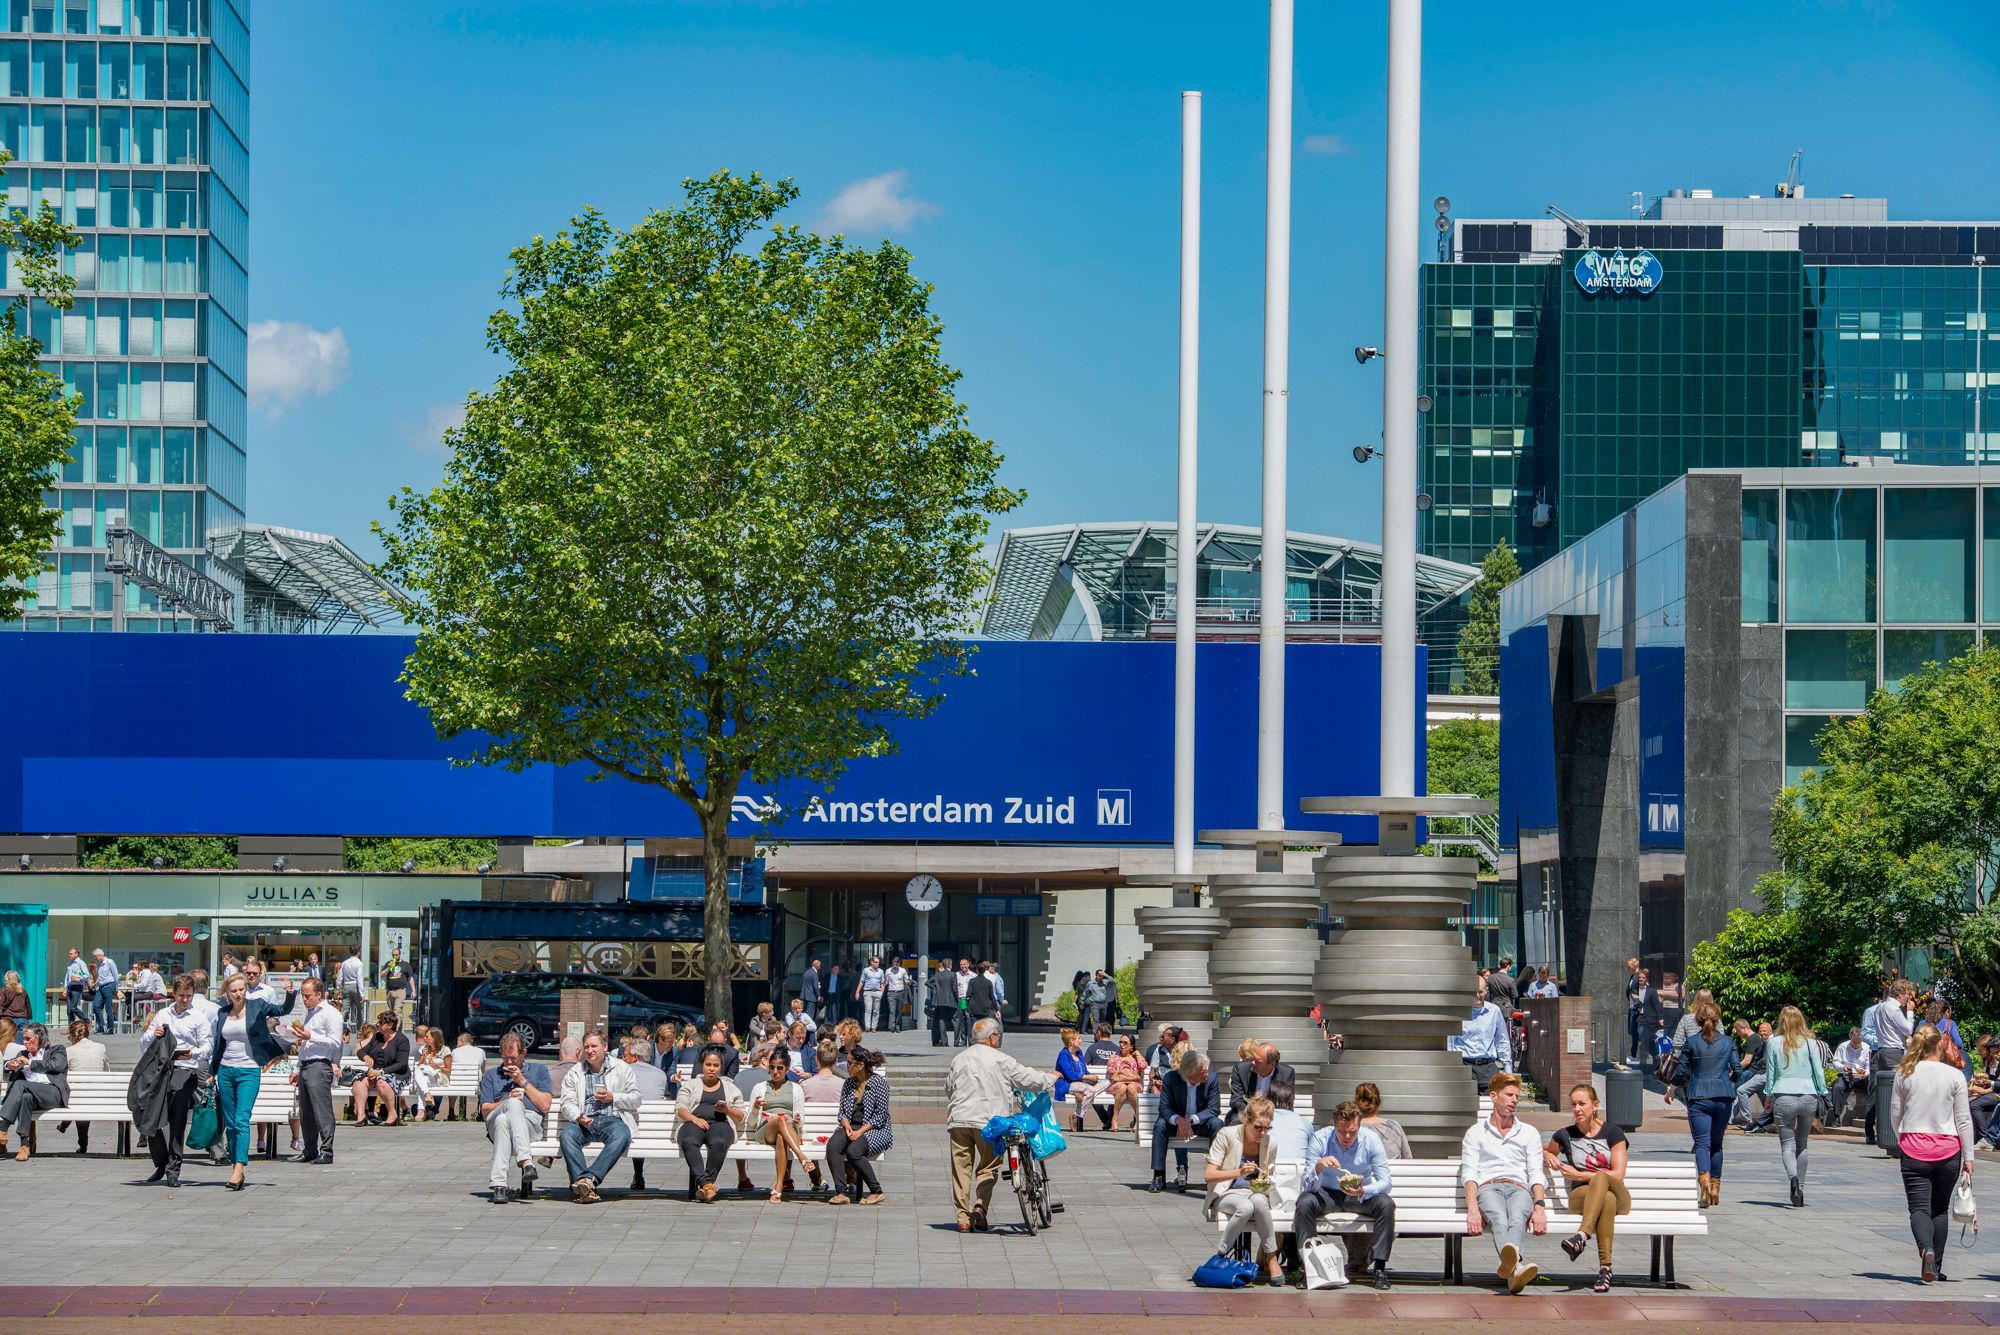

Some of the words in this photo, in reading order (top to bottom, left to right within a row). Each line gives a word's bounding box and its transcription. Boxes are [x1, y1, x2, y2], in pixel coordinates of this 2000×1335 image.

[1595, 257, 1643, 276] WTC
[1586, 278, 1652, 288] AMSTERDAM
[803, 795, 992, 823] Amsterdam
[1004, 796, 1074, 824] Zuid
[1098, 798, 1125, 824] M
[247, 886, 338, 900] JULIA'S
[174, 929, 189, 942] illy
